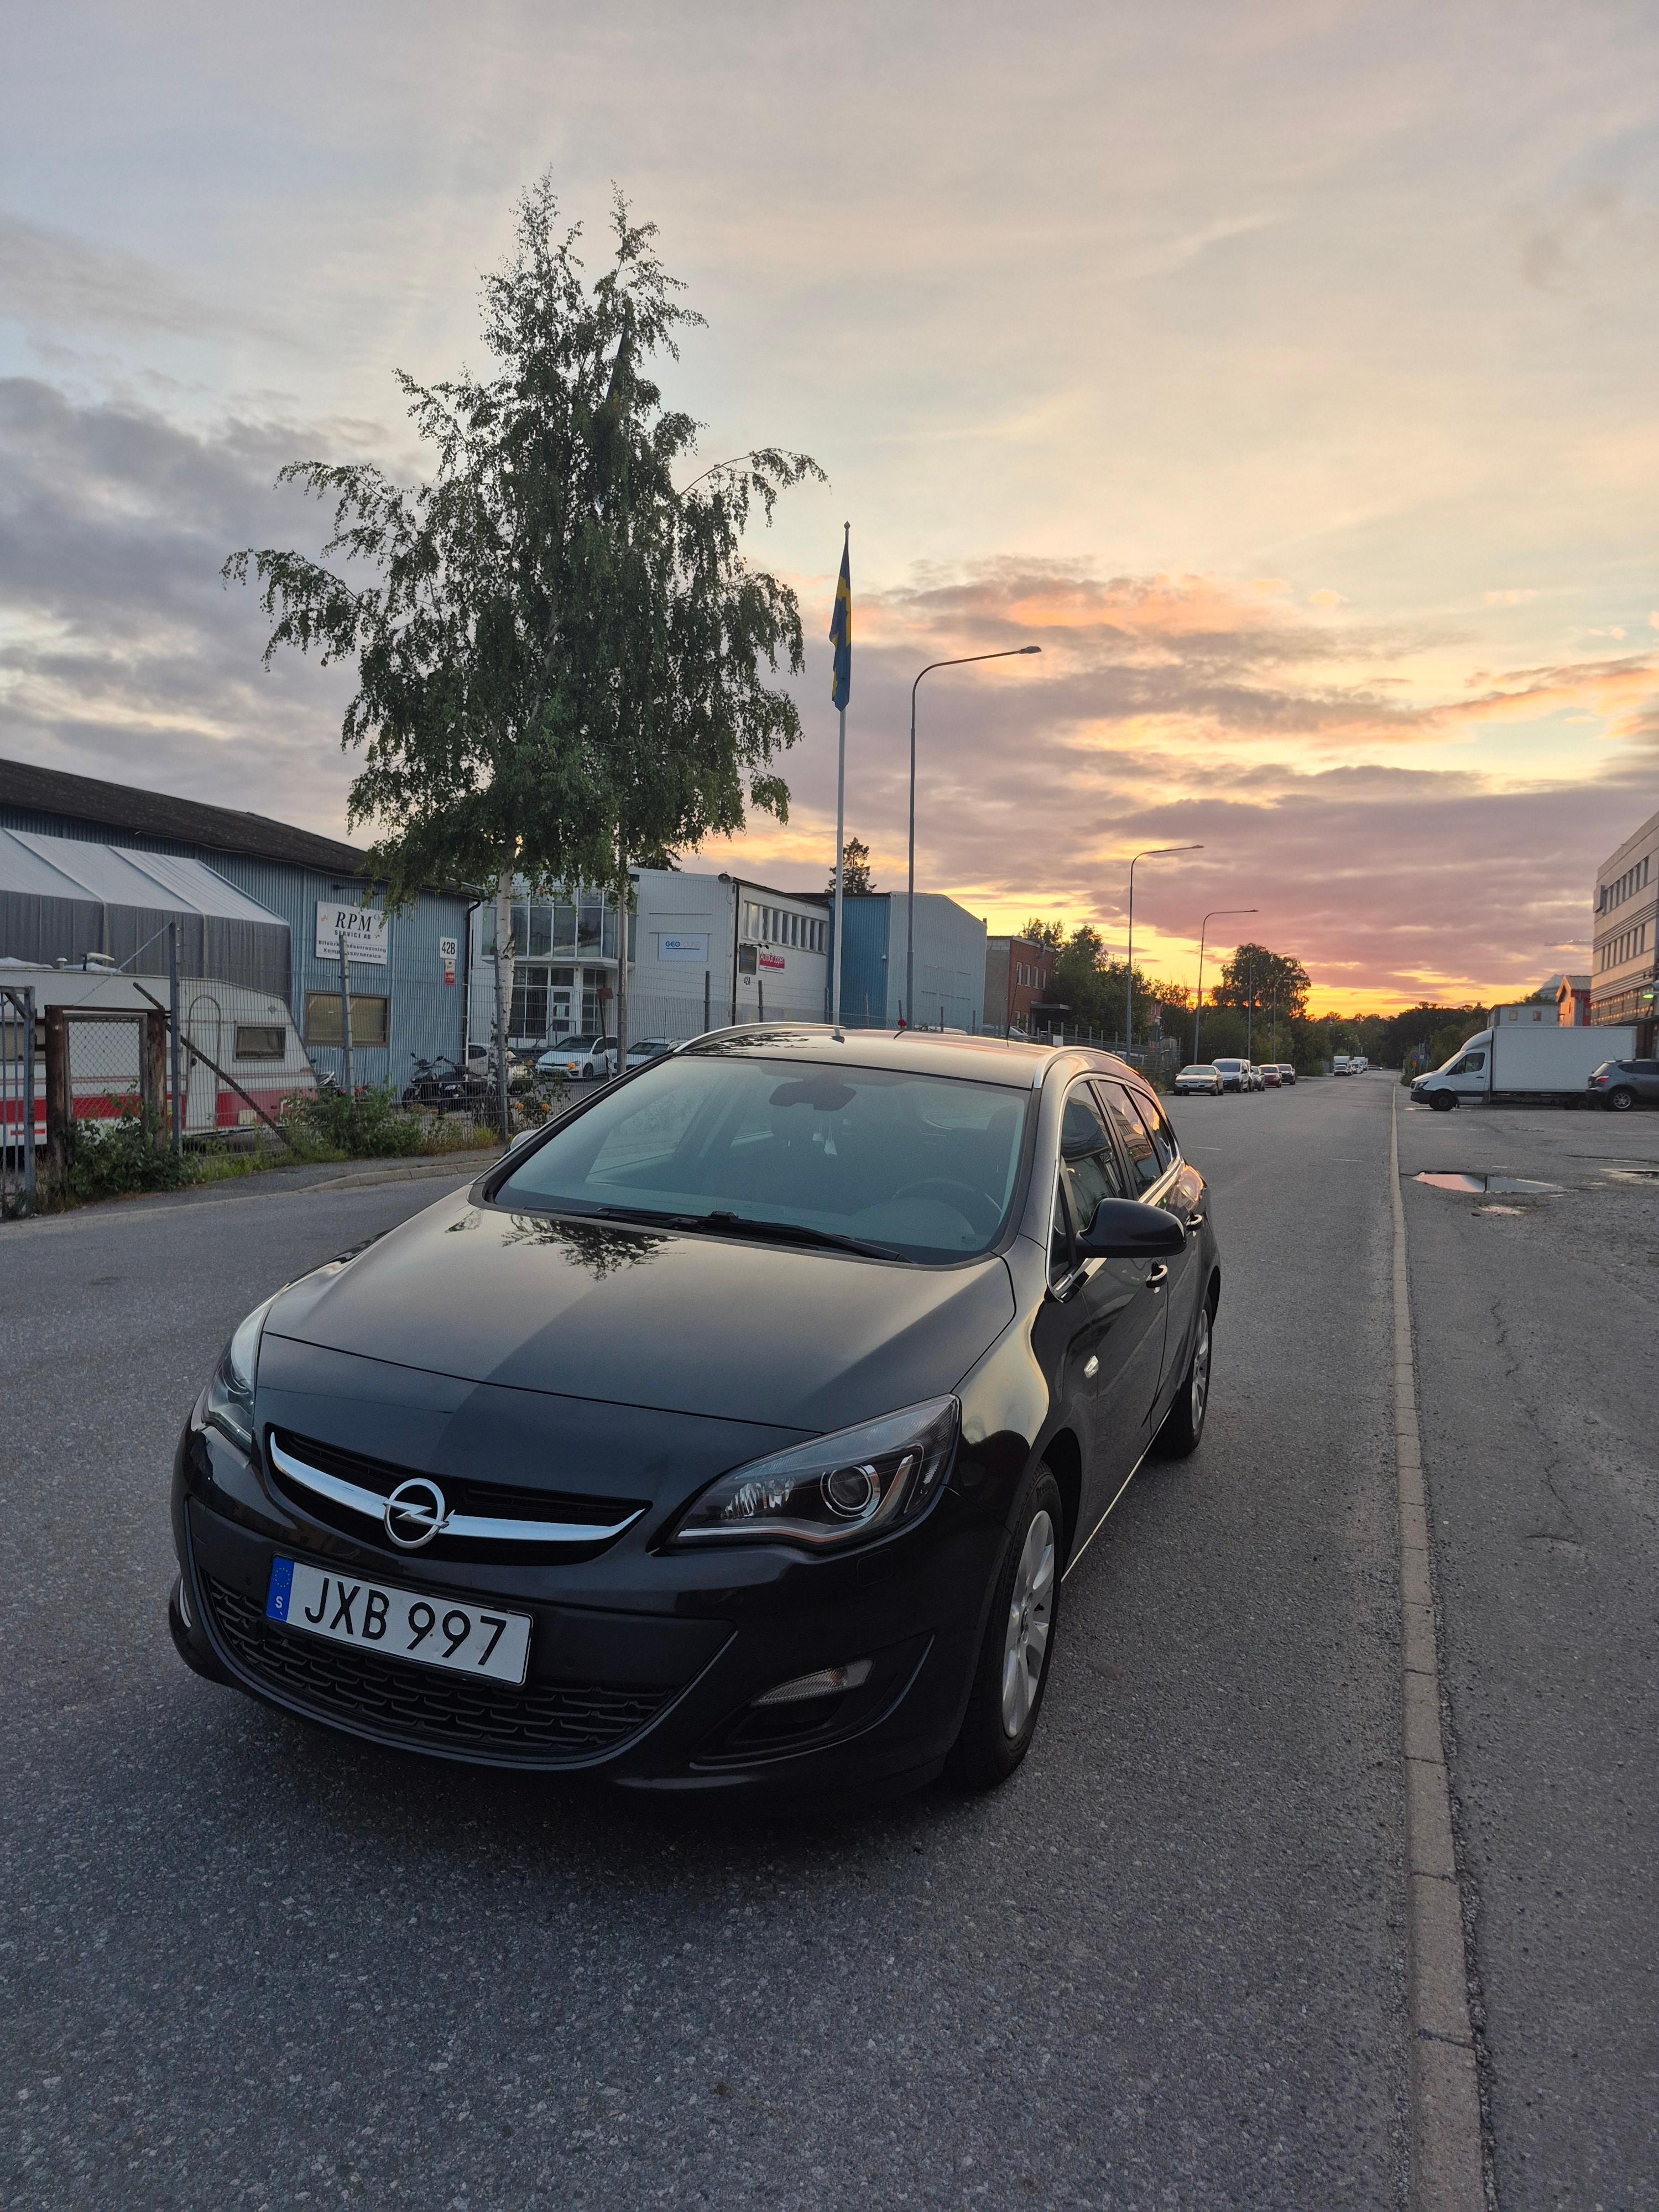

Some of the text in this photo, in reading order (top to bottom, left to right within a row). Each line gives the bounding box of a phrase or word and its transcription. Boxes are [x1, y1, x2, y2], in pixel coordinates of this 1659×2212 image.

[335, 911, 372, 932] RPM
[335, 930, 361, 938] SERVICE
[324, 948, 382, 958] Kompssorservice
[442, 941, 455, 954] 42B
[275, 1595, 283, 1609] S
[305, 1577, 507, 1666] JXB 997
